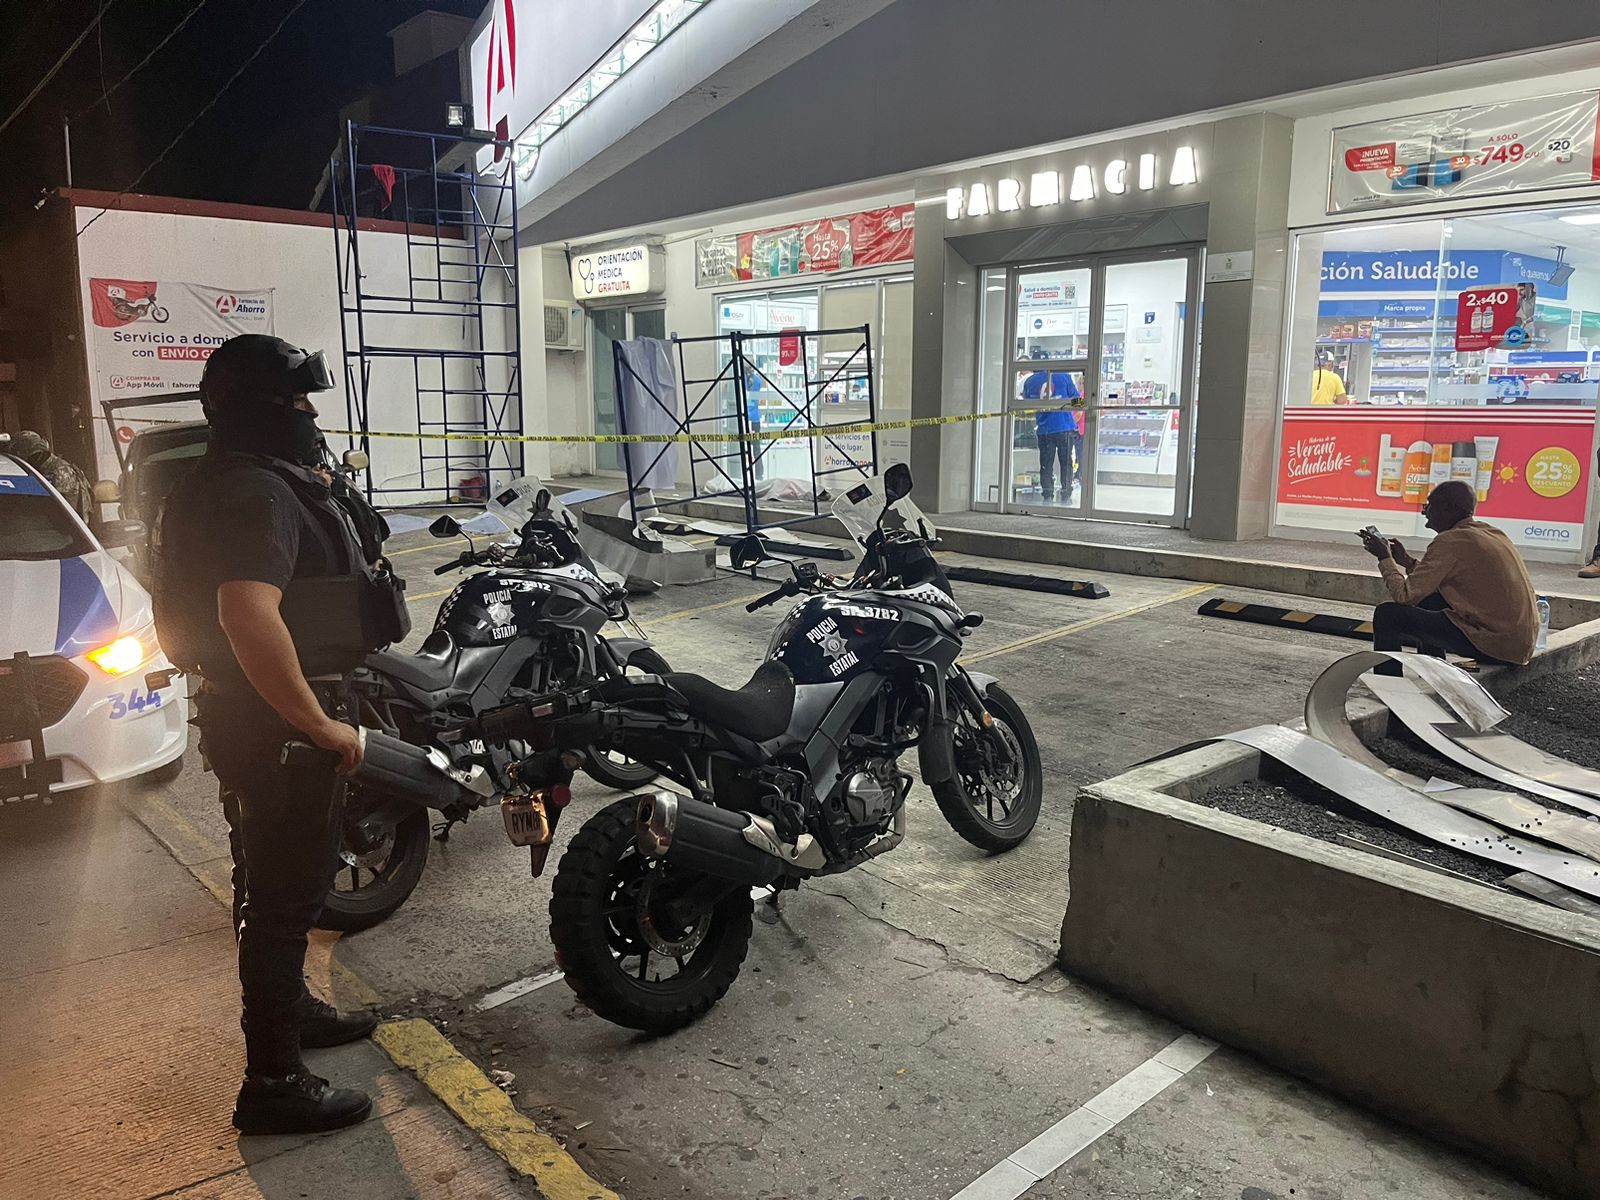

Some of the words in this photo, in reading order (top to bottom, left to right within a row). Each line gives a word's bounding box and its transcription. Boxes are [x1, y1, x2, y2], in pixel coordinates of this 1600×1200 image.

[1547, 140, 1570, 151] $20
[1474, 143, 1524, 166] $749
[946, 145, 1198, 220] FARMACIA
[597, 248, 643, 266] ORIENTACIÓN
[812, 239, 839, 260] 25%
[1320, 261, 1364, 280] ción
[1371, 260, 1479, 281] Saludable
[597, 280, 631, 293] GRATUITA
[235, 304, 266, 314] Ahorro
[1384, 304, 1404, 312] Marca
[1405, 304, 1426, 313] propia
[113, 331, 175, 344] Servicio
[180, 334, 188, 344] a
[194, 333, 230, 345] domi
[132, 349, 154, 358] con
[161, 347, 199, 359] ENVÍO
[127, 381, 142, 389] App
[835, 433, 861, 441] servicios
[846, 443, 864, 452] lugar.
[1296, 439, 1336, 458] Verano
[1287, 451, 1344, 478] Saludable
[1524, 525, 1570, 538] derma
[482, 588, 512, 605] POLICIA
[805, 616, 839, 644] POLICIA
[828, 650, 860, 677] ESTATAL
[107, 688, 162, 720] 344
